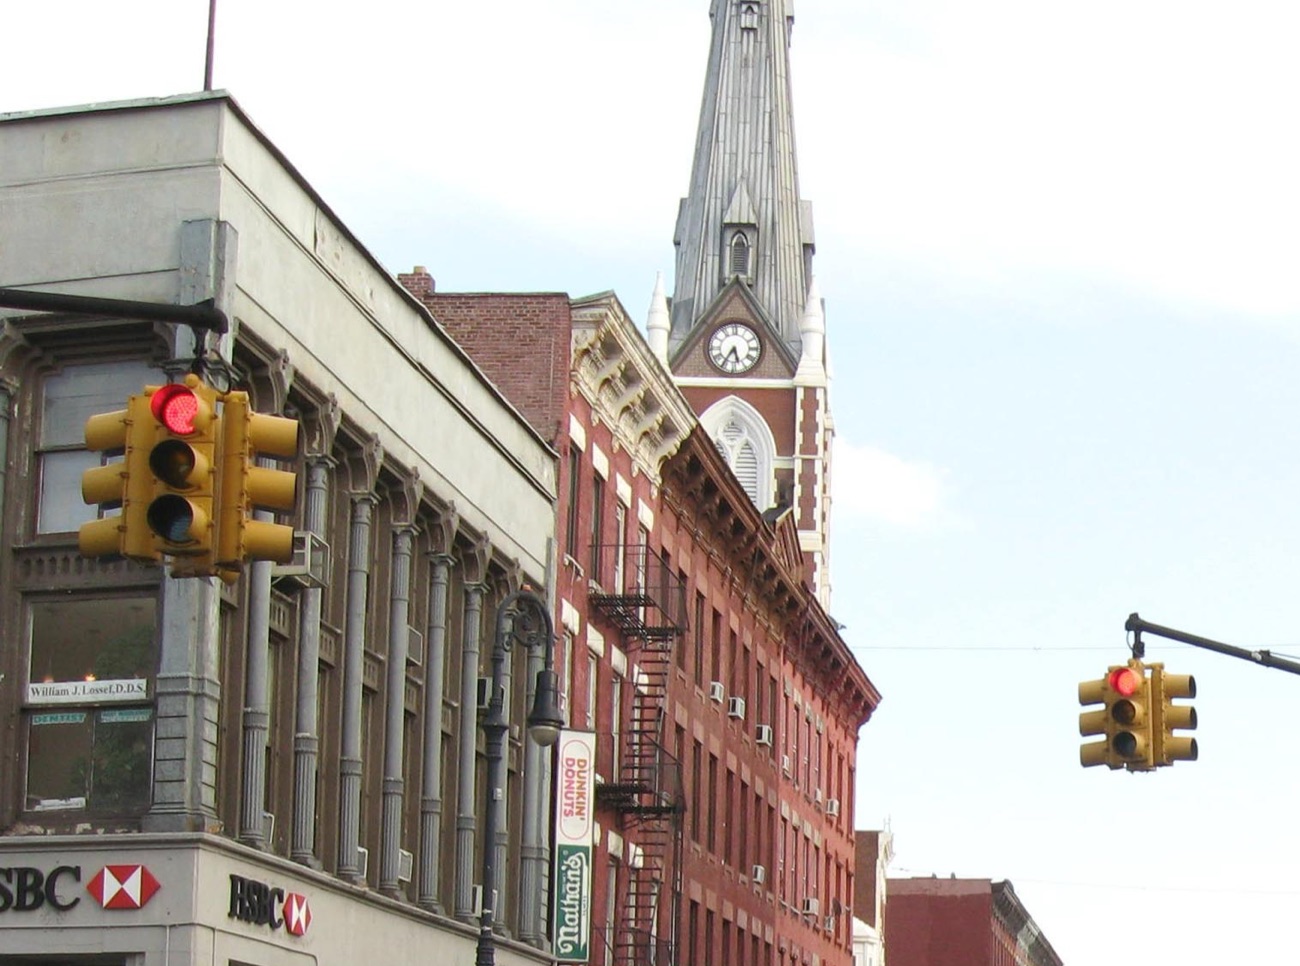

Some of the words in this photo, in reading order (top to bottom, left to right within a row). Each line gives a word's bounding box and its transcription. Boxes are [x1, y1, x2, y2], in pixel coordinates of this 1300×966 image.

[31, 686, 70, 698] William
[563, 757, 576, 819] DONUTS
[574, 758, 588, 821] DUNKIN'
[228, 873, 285, 929] HSBC
[556, 851, 586, 955] Nathan's
